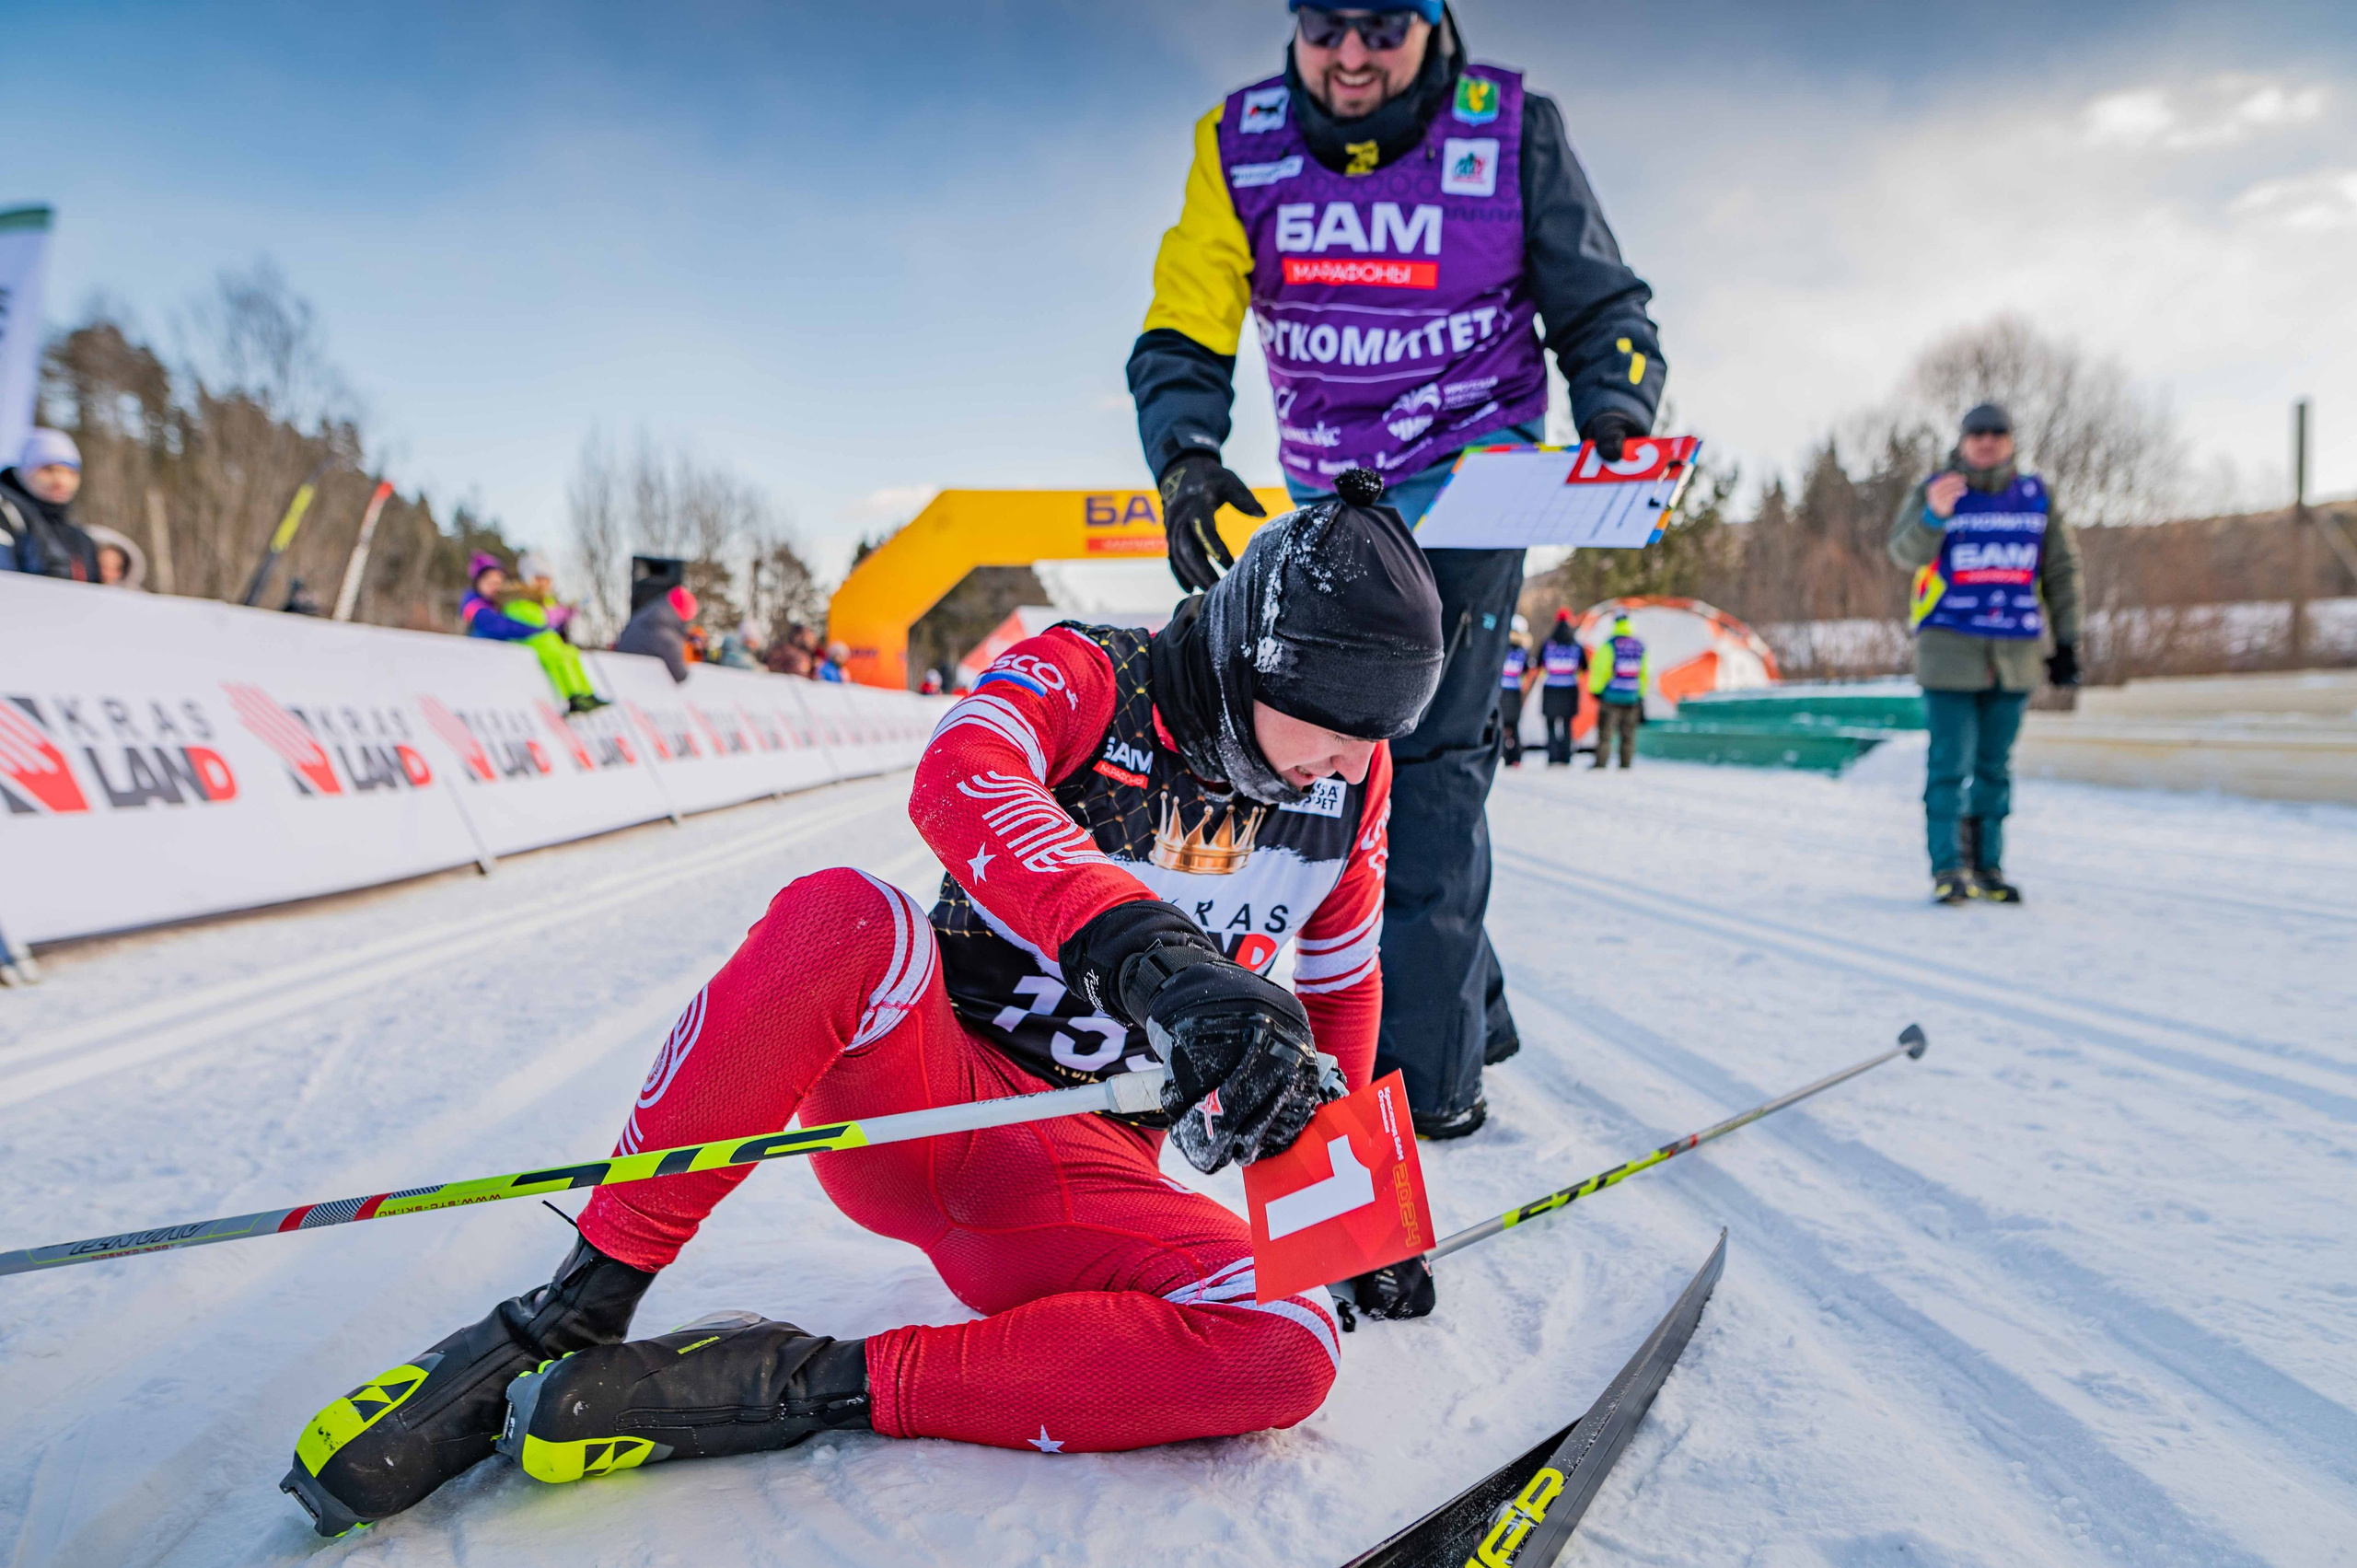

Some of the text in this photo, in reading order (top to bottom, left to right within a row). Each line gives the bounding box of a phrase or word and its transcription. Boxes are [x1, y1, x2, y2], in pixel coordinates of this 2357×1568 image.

[1275, 202, 1444, 255] БАМ
[1292, 261, 1411, 285] МАРАФОНЫ
[1086, 495, 1156, 526] БА
[987, 654, 1065, 691] SCO
[50, 695, 217, 739] KRAS
[83, 746, 238, 808] LAND
[1172, 899, 1289, 934] RAS
[378, 1193, 502, 1218] WWW.STC-SKI.RU
[1265, 1134, 1376, 1241] 1
[1392, 1162, 1422, 1248] 2024
[1464, 1467, 1565, 1568] ER
